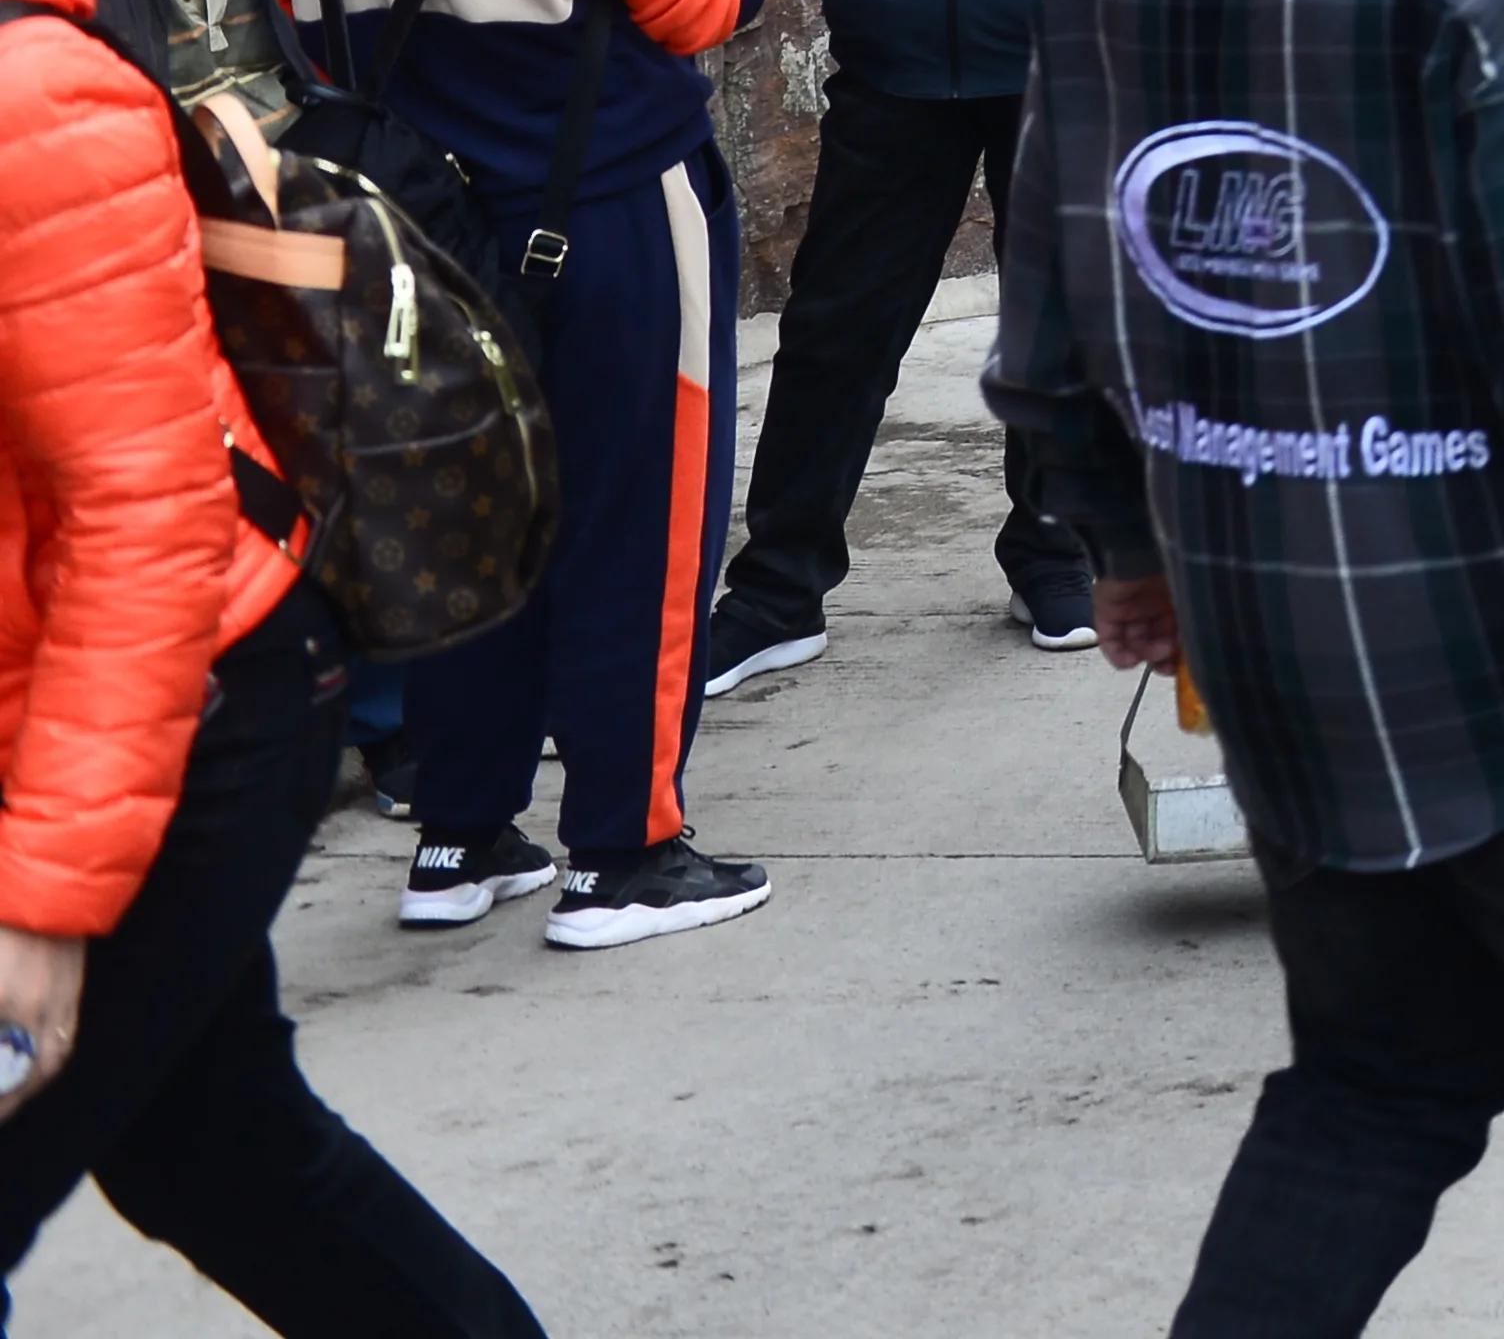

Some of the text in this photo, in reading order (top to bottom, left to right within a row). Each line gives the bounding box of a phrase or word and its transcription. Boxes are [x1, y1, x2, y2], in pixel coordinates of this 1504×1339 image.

[1176, 400, 1351, 487] Management
[1360, 414, 1490, 477] Games
[417, 846, 466, 869] NIKE
[563, 870, 599, 894] IKE
